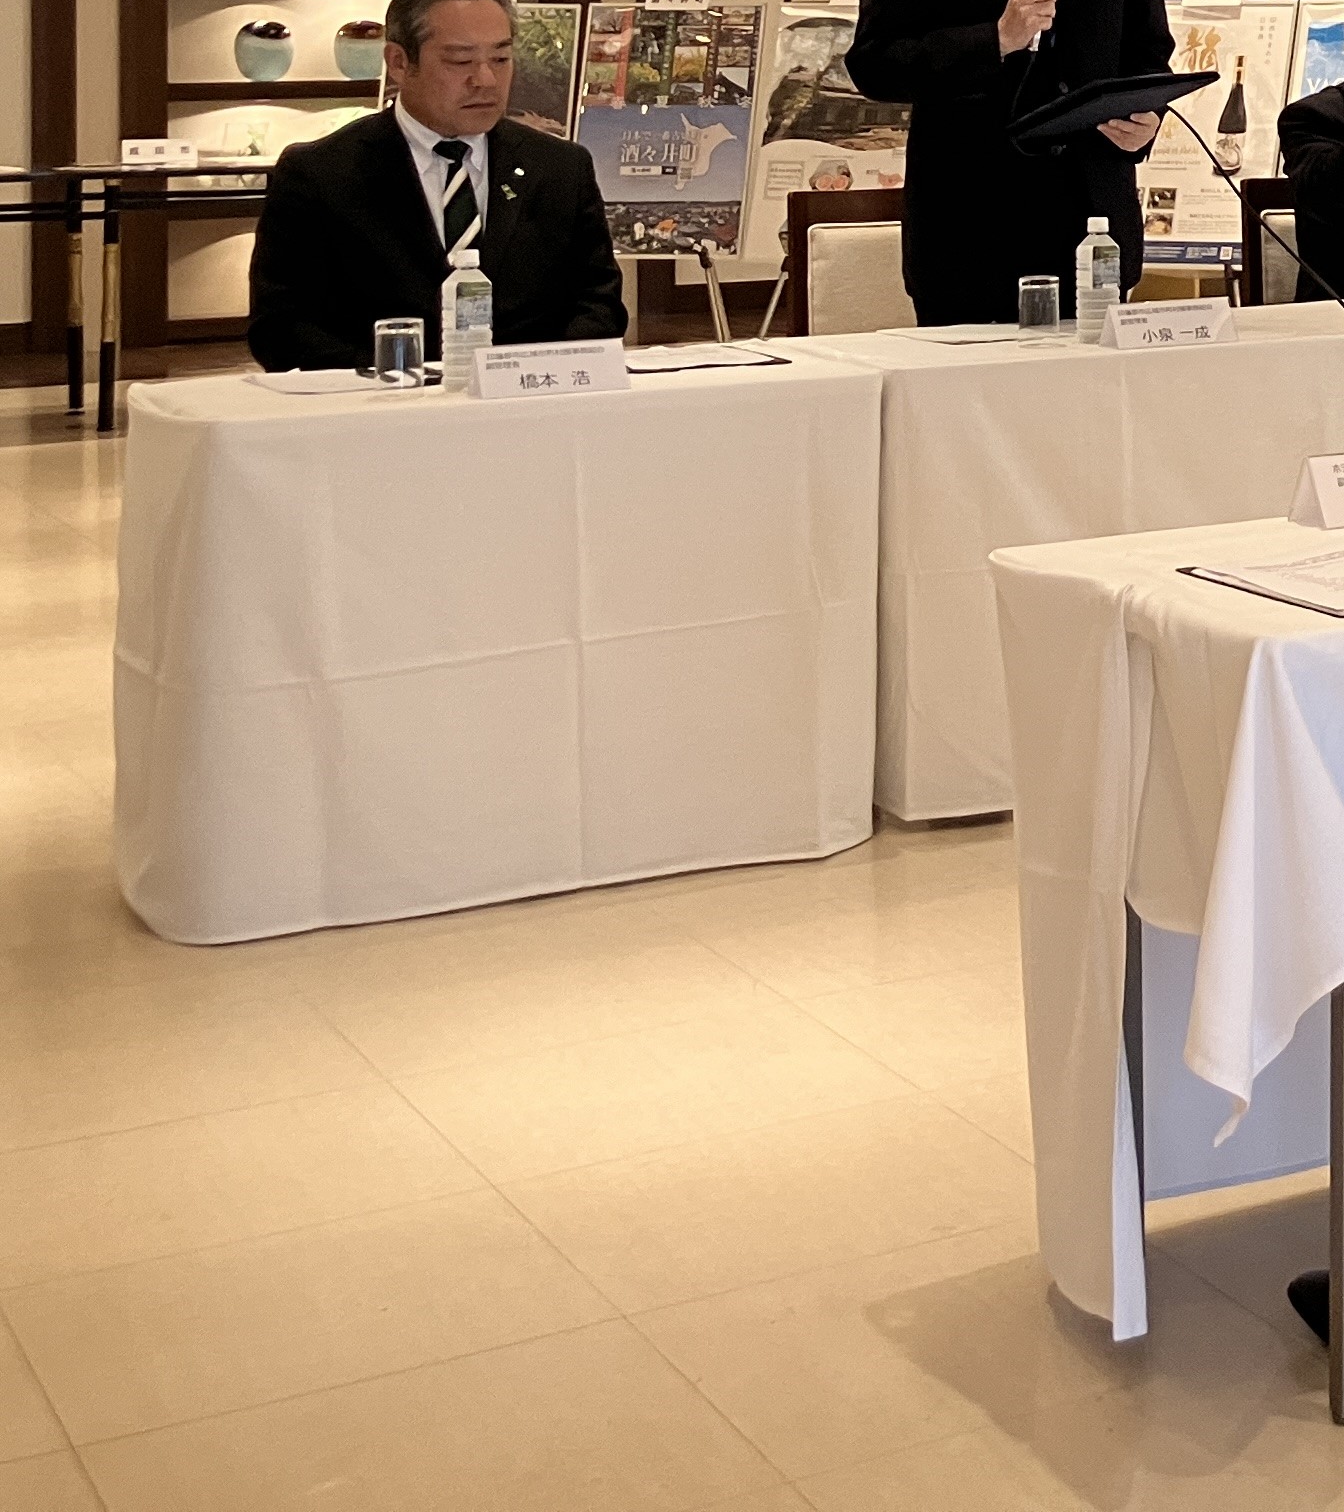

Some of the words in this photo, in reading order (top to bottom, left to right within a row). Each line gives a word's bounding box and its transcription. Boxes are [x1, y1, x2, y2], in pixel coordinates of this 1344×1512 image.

[620, 143, 697, 163] 酒々井町
[1142, 327, 1174, 344] 小泉
[1179, 325, 1211, 340] 一成
[519, 372, 560, 390] 橋本
[570, 369, 591, 386] 浩
